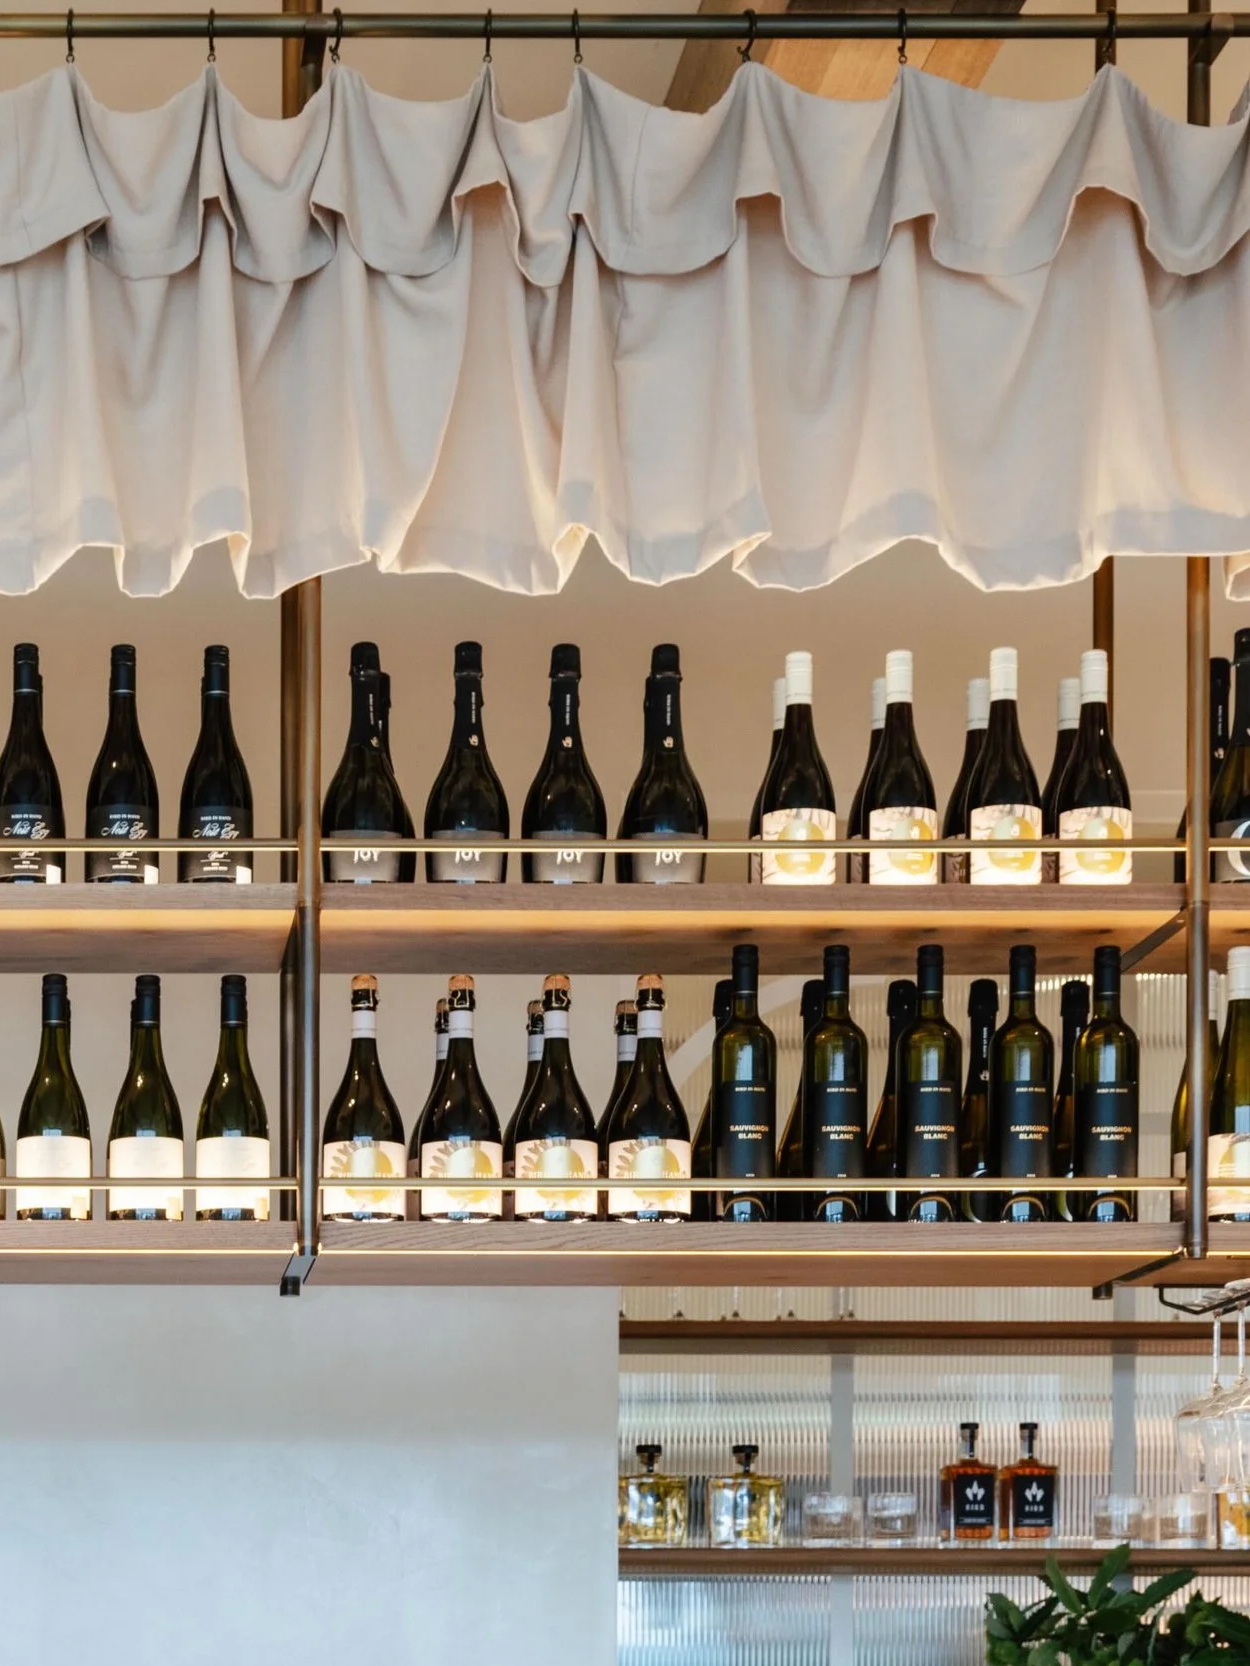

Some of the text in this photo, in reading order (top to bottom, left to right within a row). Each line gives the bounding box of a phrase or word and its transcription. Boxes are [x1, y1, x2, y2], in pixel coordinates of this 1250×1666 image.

[354, 848, 382, 864] JOY
[455, 848, 483, 864] JOY
[556, 848, 584, 865] JOY
[655, 848, 684, 866] JOY
[729, 1124, 769, 1132] SAUVIGNON
